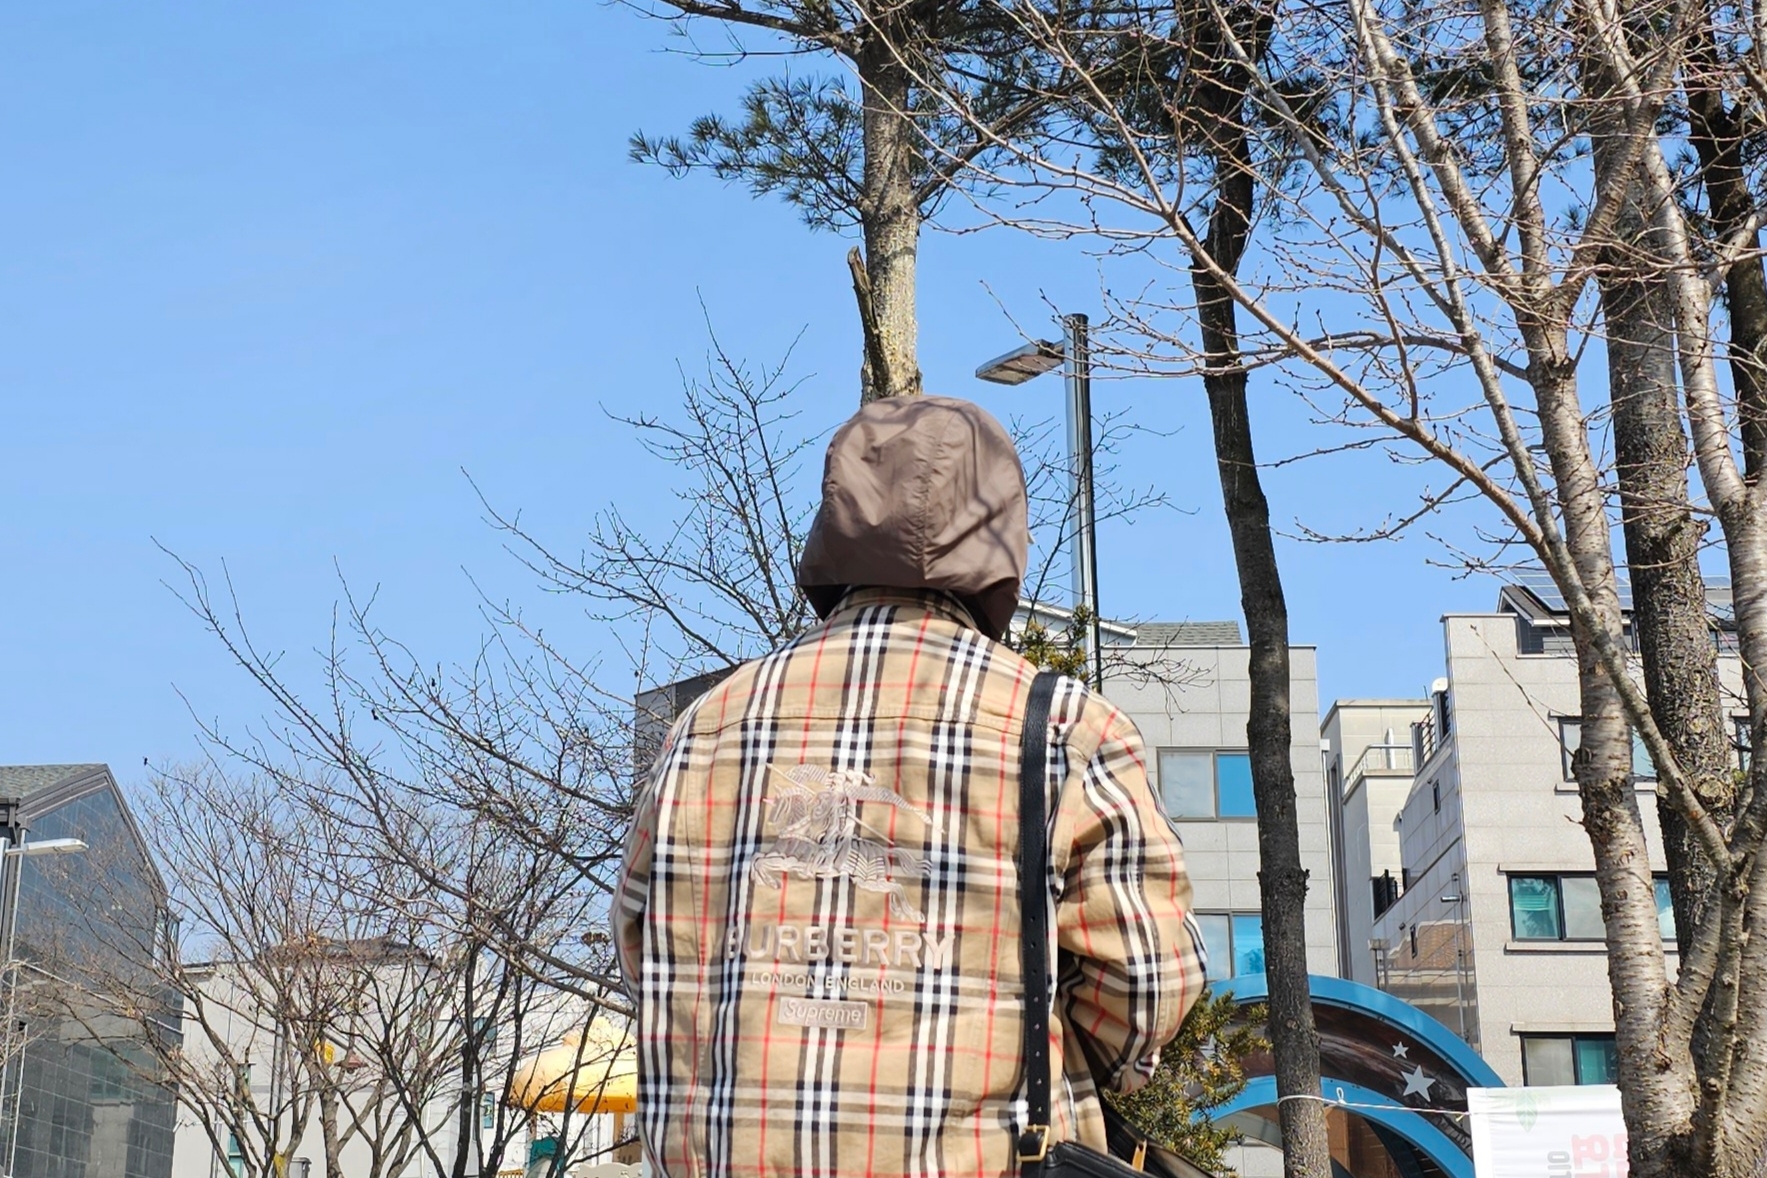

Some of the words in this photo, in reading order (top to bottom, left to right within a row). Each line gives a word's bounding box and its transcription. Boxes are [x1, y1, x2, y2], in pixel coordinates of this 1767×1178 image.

[723, 924, 956, 970] BURBERRY
[751, 971, 818, 990] LONDON
[824, 974, 905, 993] ENGLAND
[785, 999, 863, 1026] Supreme
